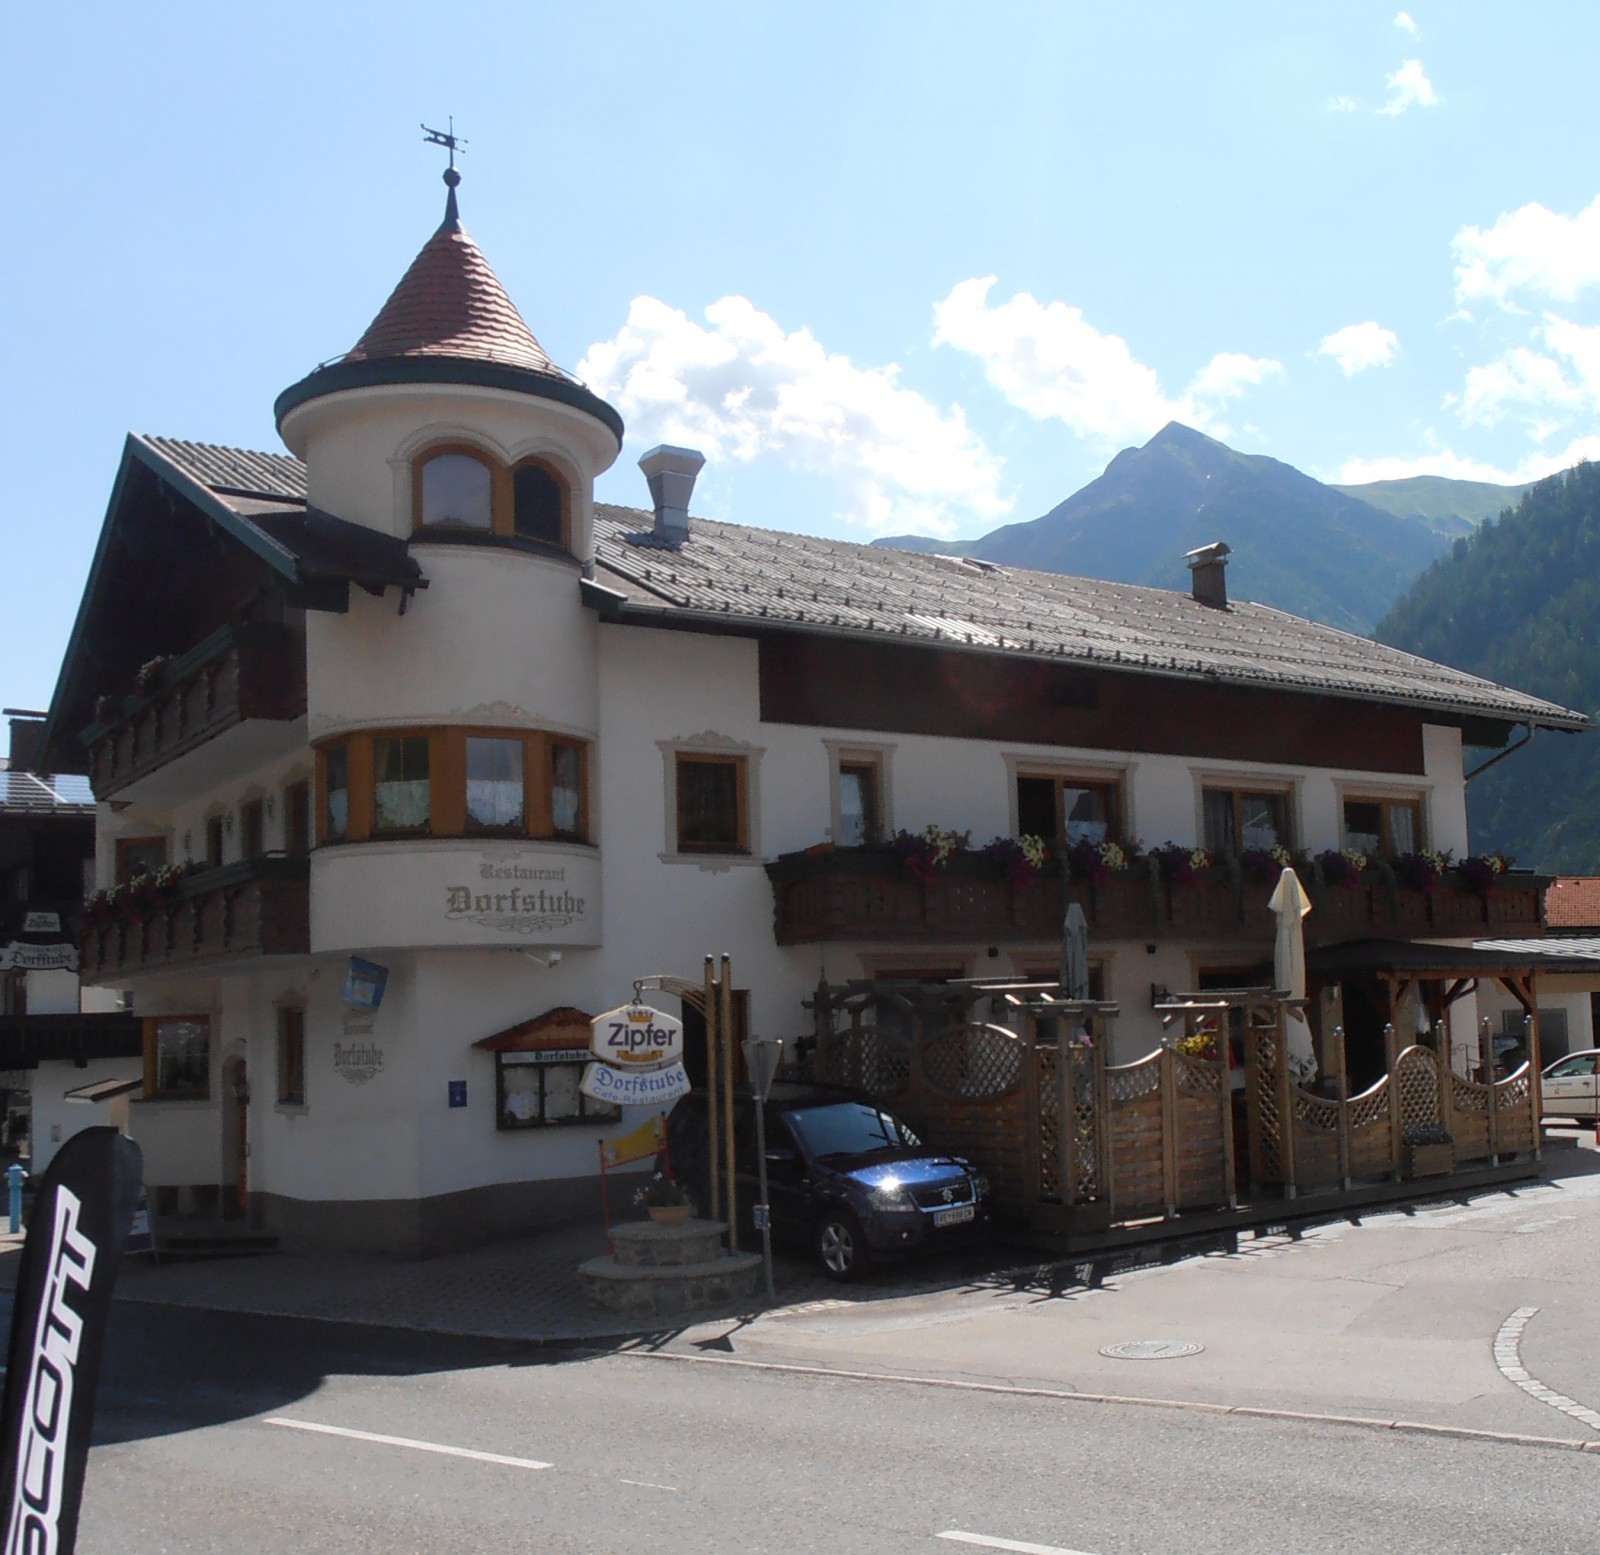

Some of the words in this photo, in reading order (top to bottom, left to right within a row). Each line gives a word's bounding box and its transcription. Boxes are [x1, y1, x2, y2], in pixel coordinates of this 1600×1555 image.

[480, 863, 565, 881] Restaurant
[446, 886, 585, 914] Dorfstube
[608, 1023, 677, 1052] Zipfer
[334, 1042, 384, 1065] Dorfstube
[535, 1050, 588, 1061] Dorfstube
[595, 1067, 684, 1094] Dorfstube
